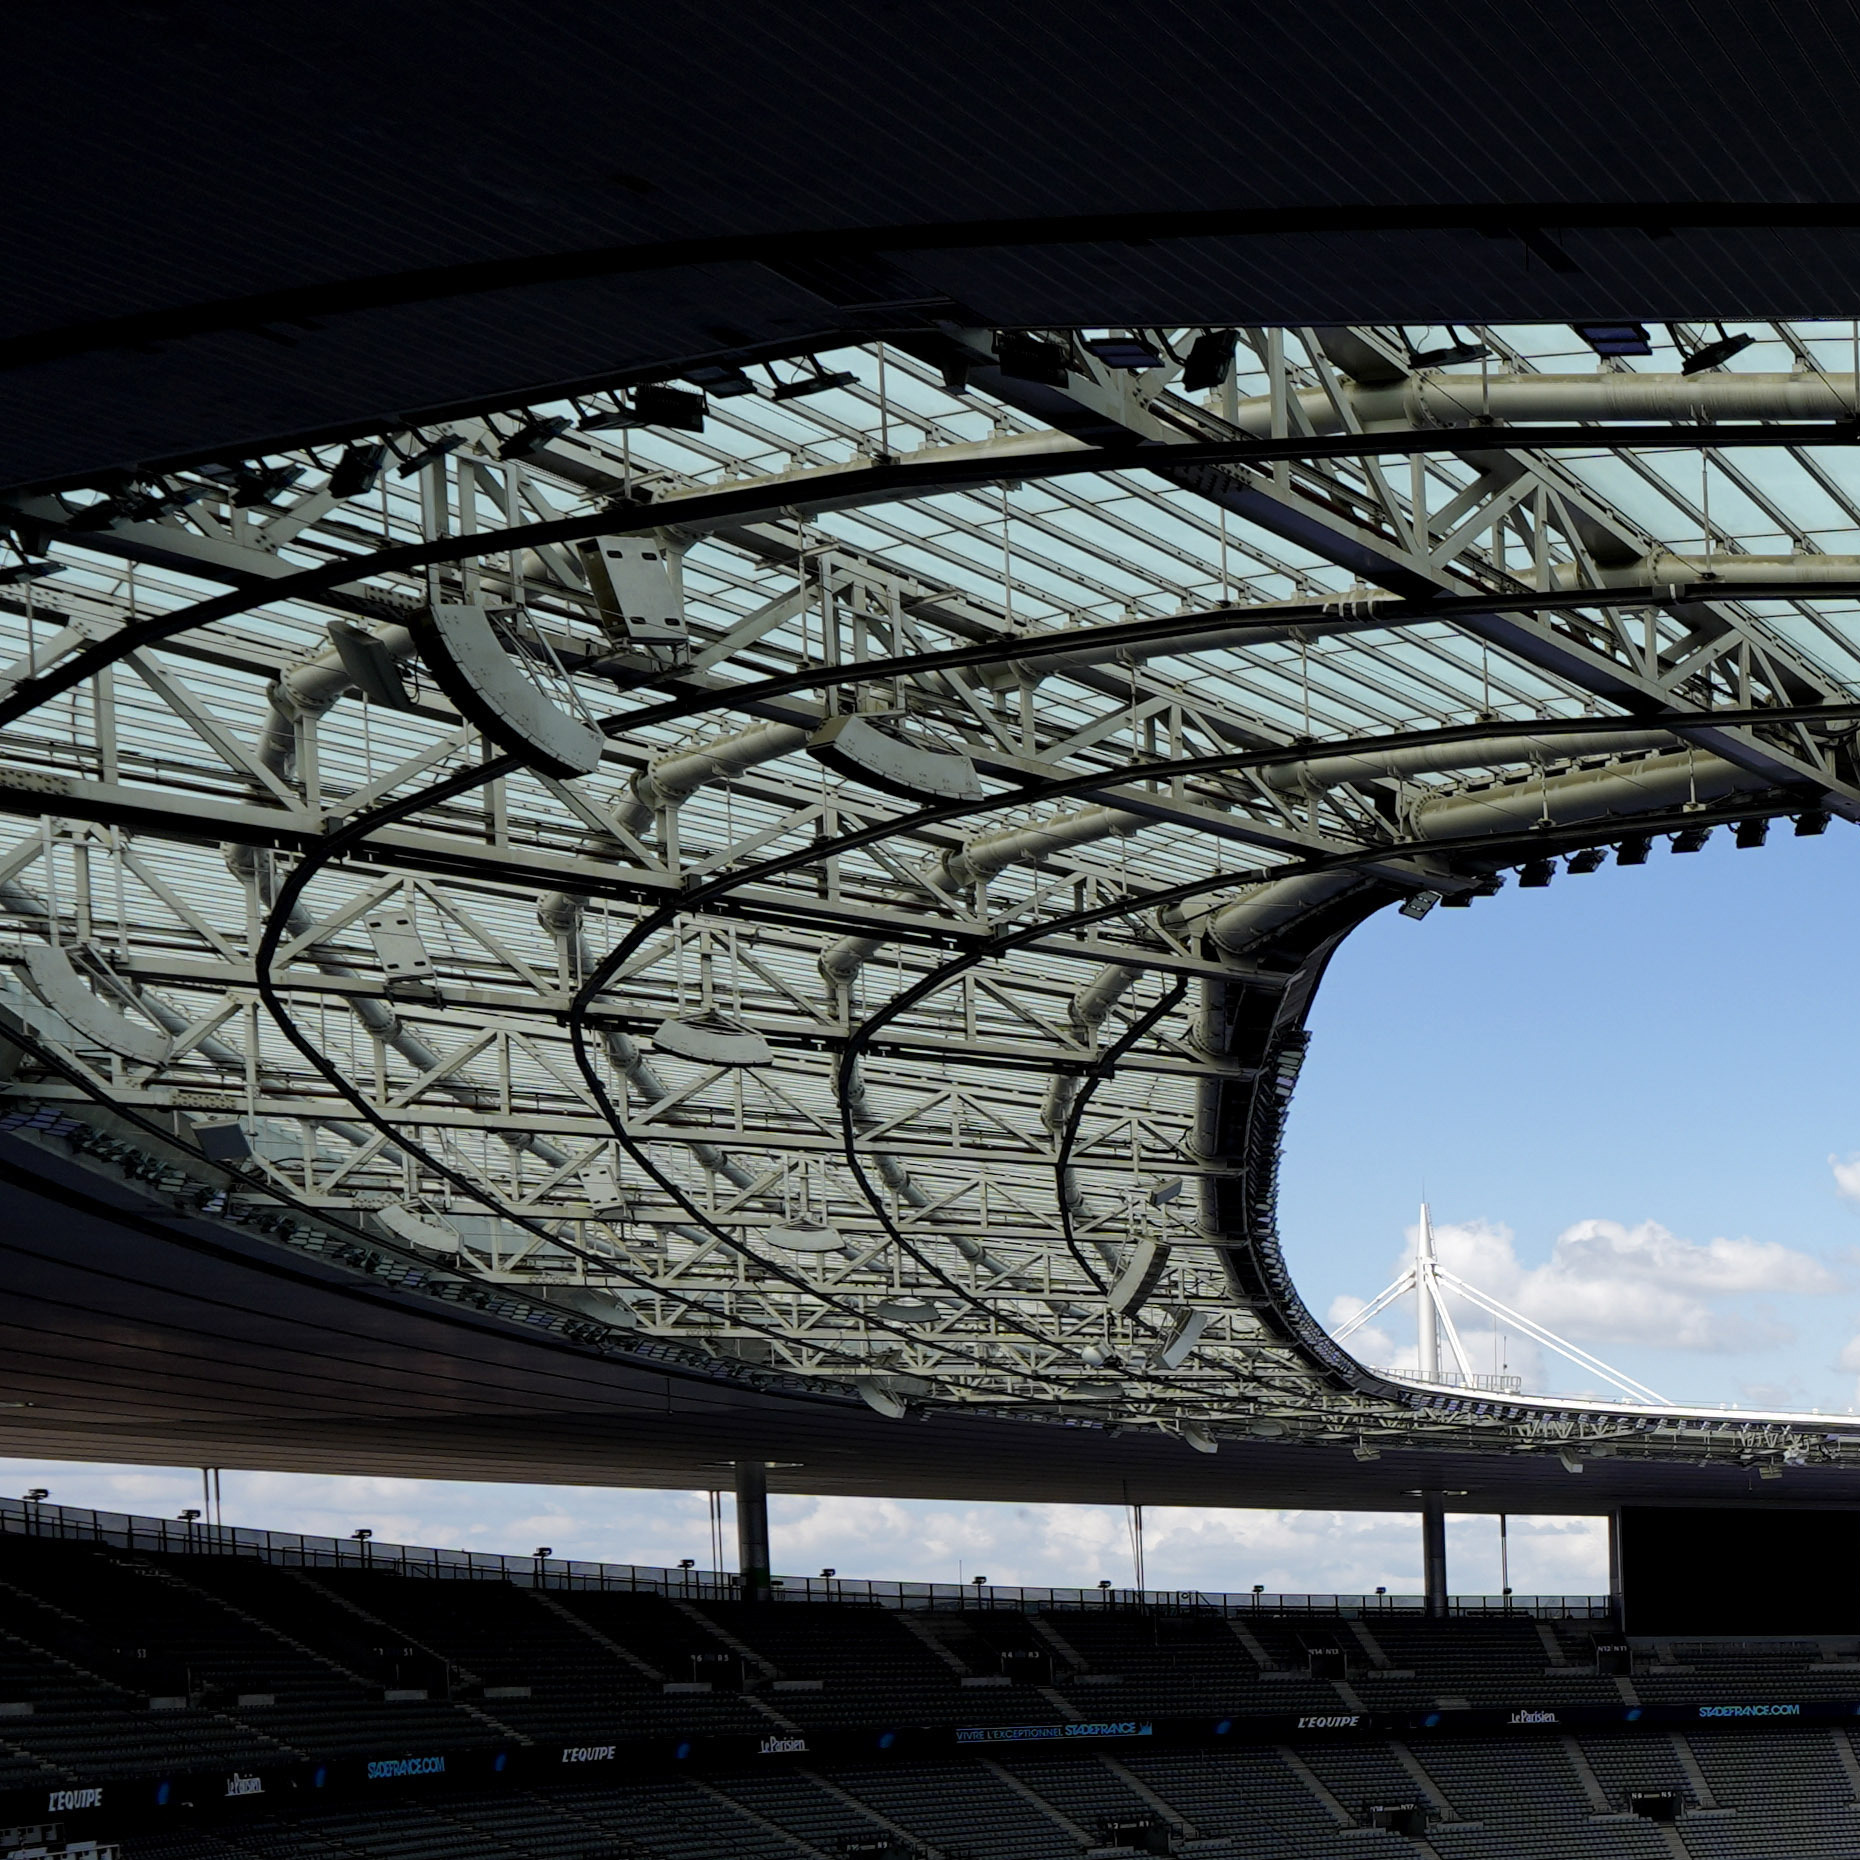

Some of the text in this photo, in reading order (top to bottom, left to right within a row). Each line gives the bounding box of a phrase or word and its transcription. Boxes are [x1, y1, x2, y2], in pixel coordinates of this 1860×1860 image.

[1520, 1710, 1555, 1723] Parisien
[1698, 1704, 1800, 1718] STADEFRANCE.COM
[956, 1729, 984, 1741] VIVRE
[987, 1726, 1063, 1739] L'EXCEPTIONNEL
[770, 1736, 806, 1752] Parisien
